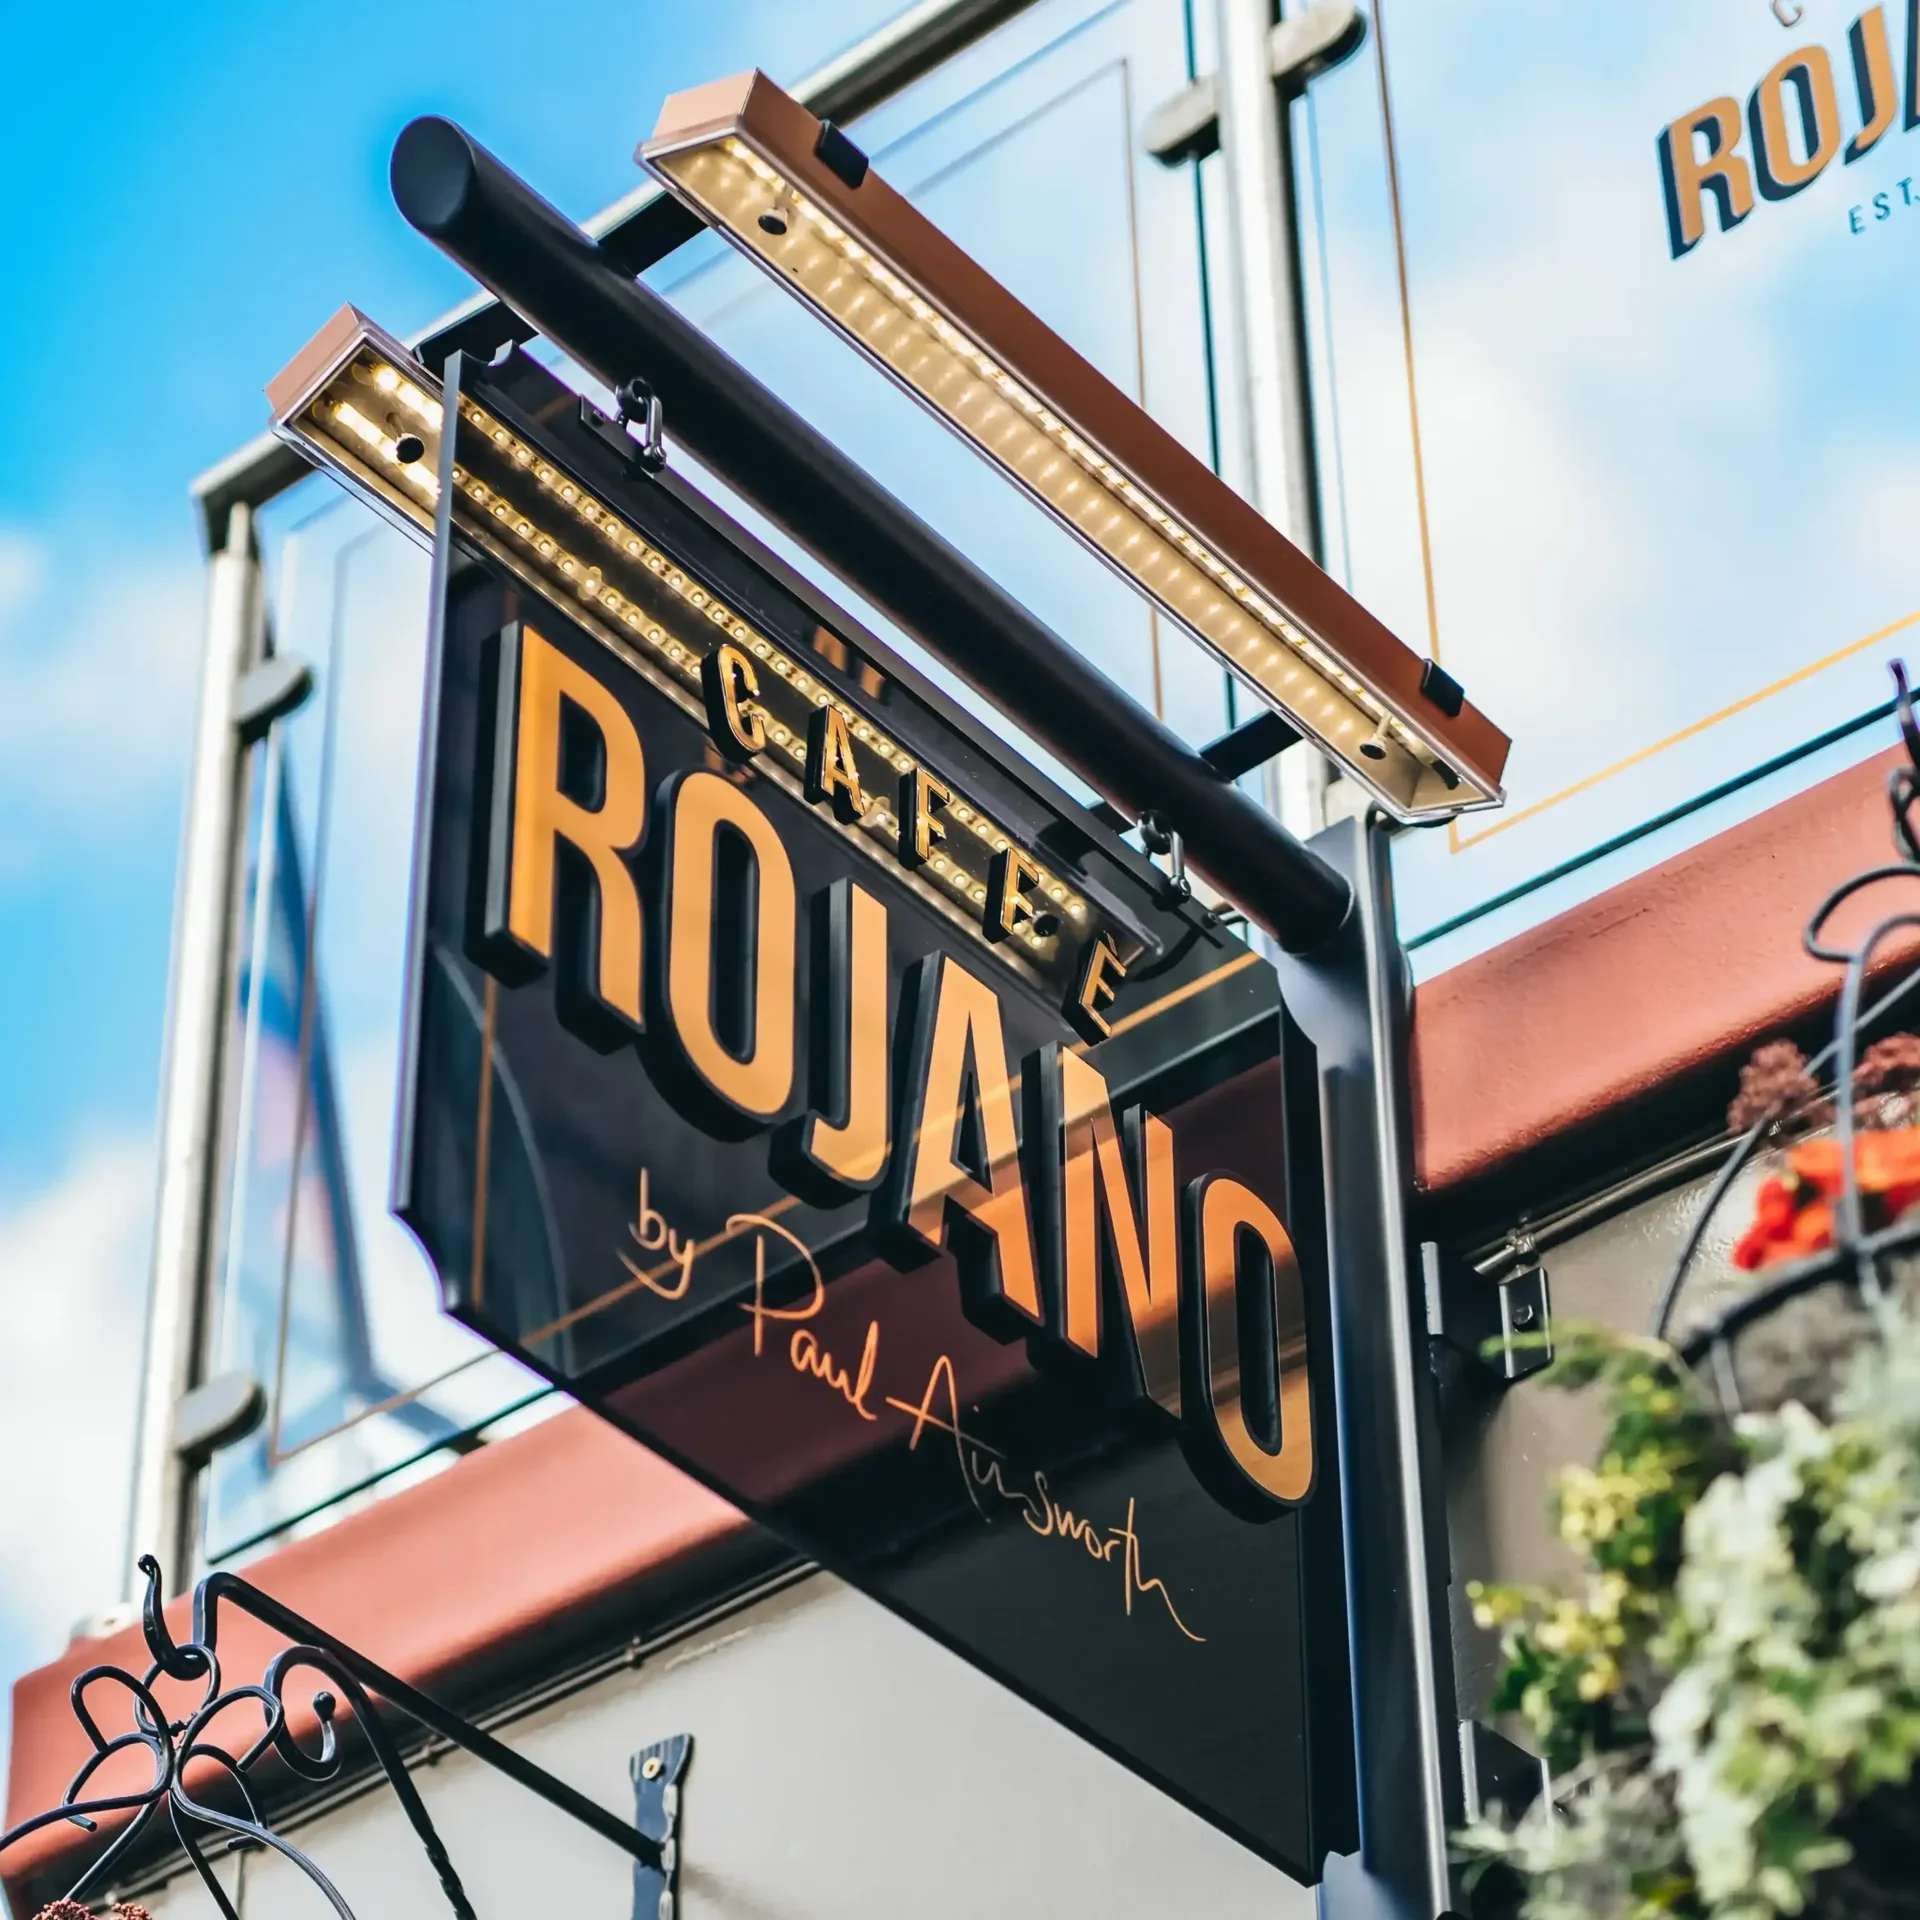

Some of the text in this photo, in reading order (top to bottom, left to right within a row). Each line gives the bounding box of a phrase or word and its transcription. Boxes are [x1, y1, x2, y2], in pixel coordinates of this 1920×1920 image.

[1655, 0, 1920, 261] ROJ
[484, 620, 1316, 1512] ROJANO
[615, 1165, 697, 1300] by
[725, 1212, 880, 1421] Paul
